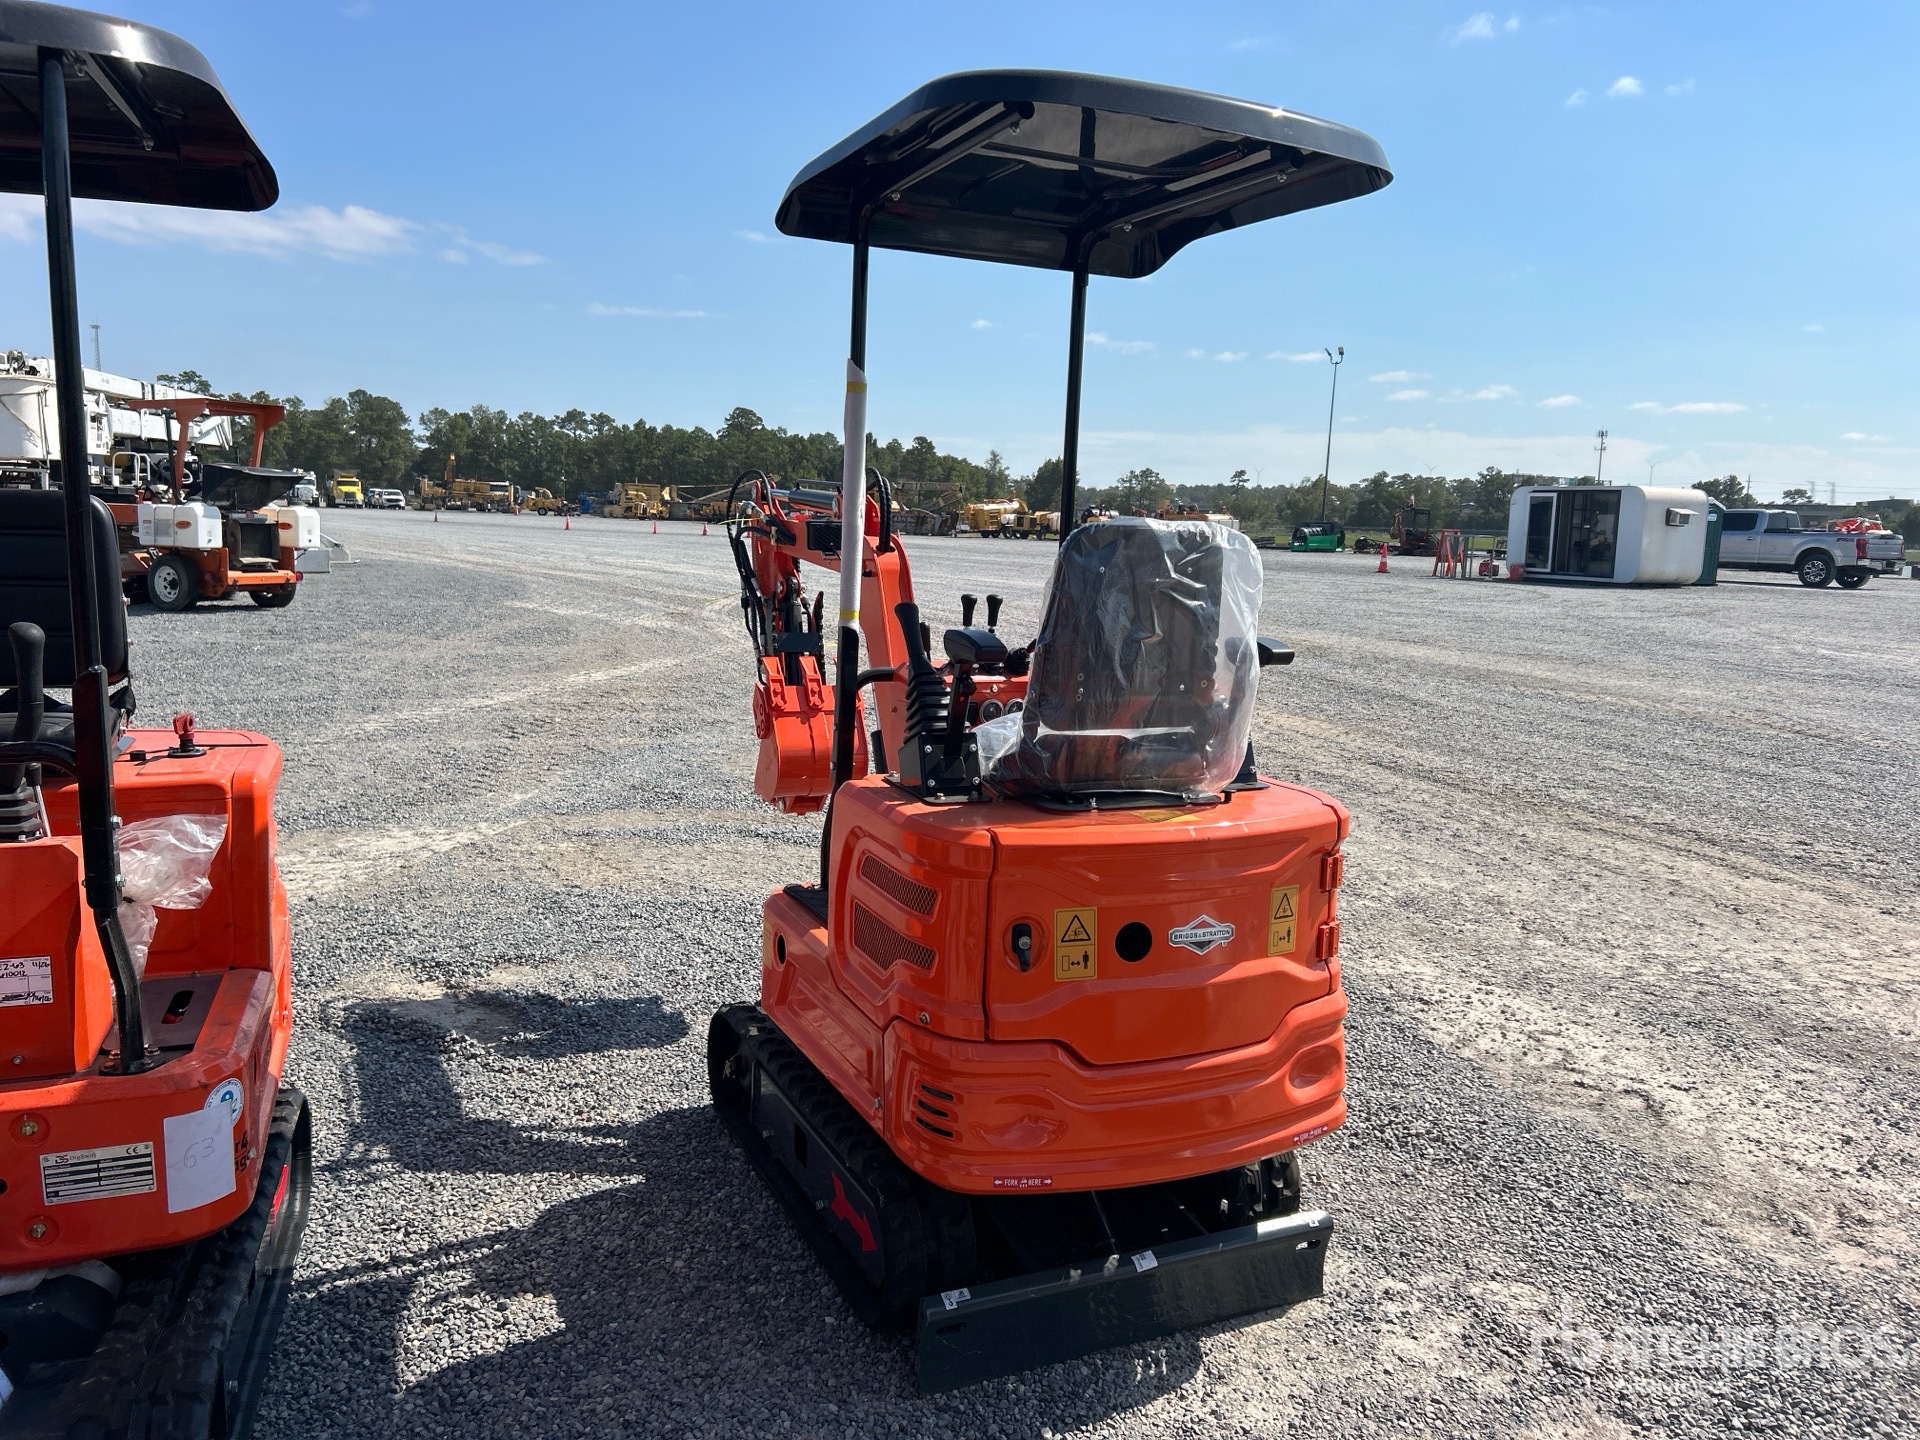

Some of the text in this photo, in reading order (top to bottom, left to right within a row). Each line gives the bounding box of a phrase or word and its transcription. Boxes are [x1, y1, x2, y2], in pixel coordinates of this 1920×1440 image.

[69, 1152, 97, 1161] DigSwift
[1004, 1178, 1042, 1186] FORK HERE
